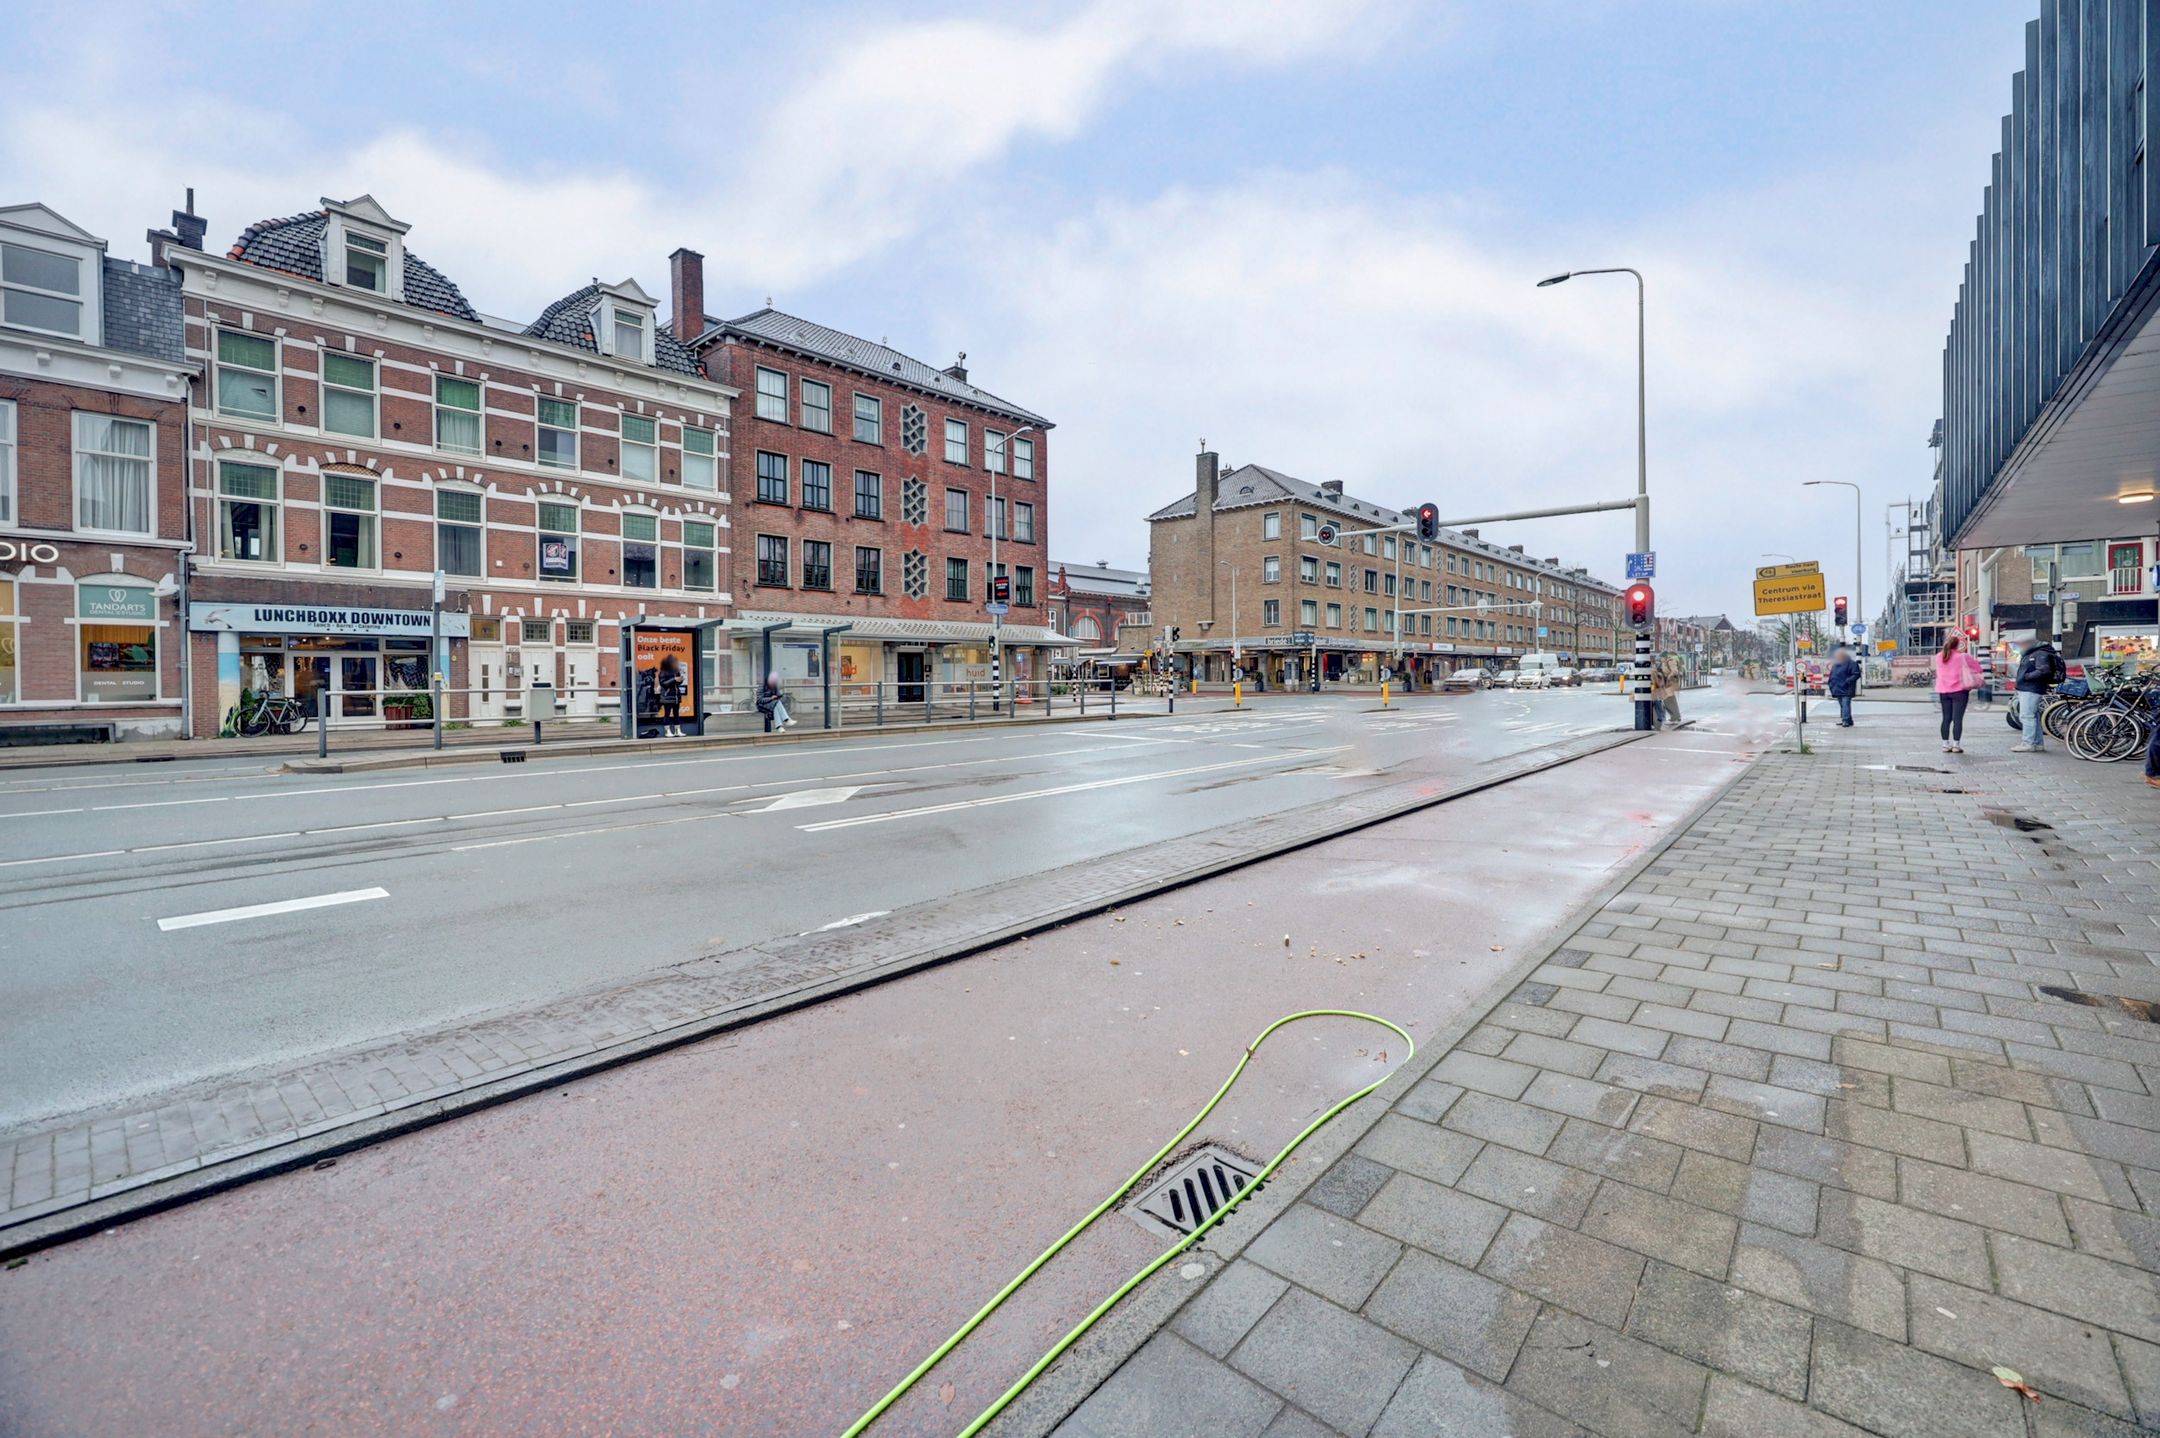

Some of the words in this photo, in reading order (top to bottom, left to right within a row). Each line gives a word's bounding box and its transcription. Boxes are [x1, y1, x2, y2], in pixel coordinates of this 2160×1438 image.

[1762, 586, 1799, 595] Centrum
[1758, 592, 1821, 604] Theresiastraat
[89, 602, 146, 612] TANDARTS
[254, 608, 347, 624] LUNCHBOXX
[351, 612, 431, 627] DOWNTOWN
[660, 636, 682, 644] beste
[661, 645, 686, 653] Friday
[966, 668, 985, 677] huid
